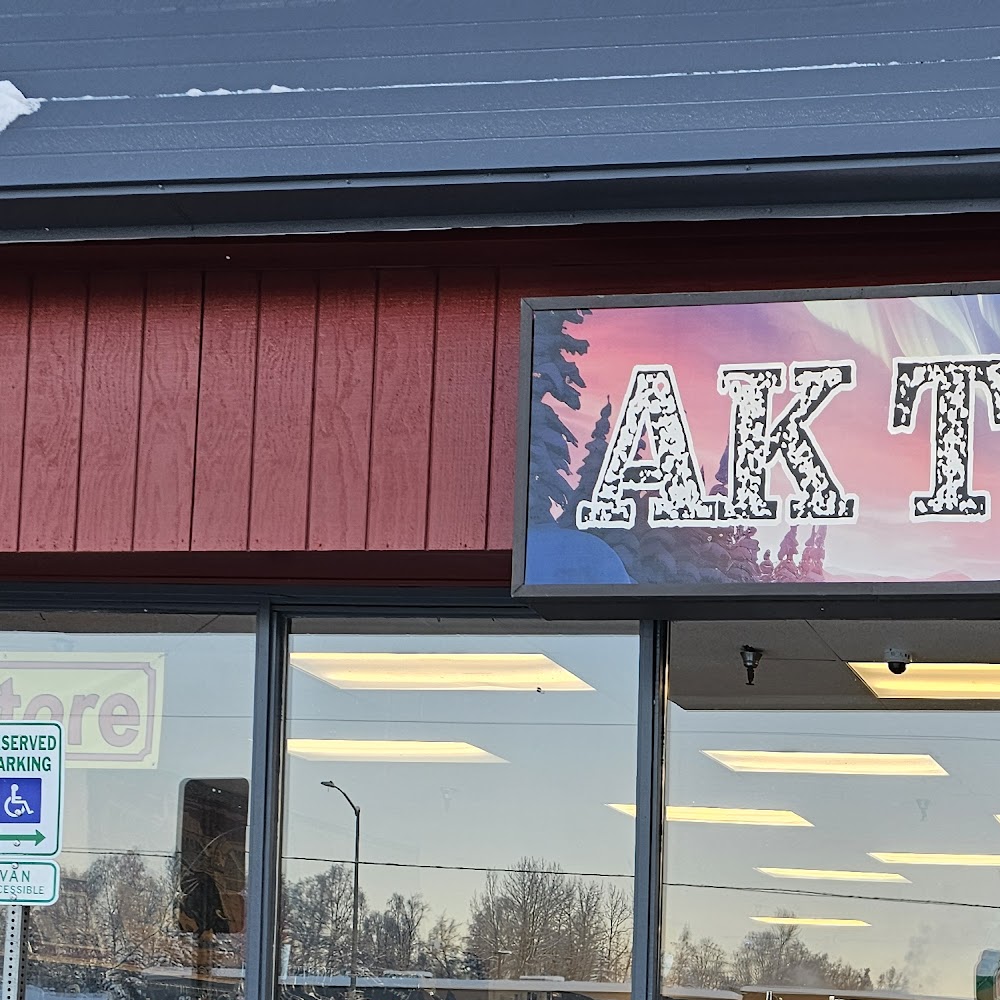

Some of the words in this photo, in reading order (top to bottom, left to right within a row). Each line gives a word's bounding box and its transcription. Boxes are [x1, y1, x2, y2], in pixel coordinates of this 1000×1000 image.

[576, 362, 858, 529] AK
[0, 735, 57, 751] SERVED
[0, 869, 30, 883] VAN
